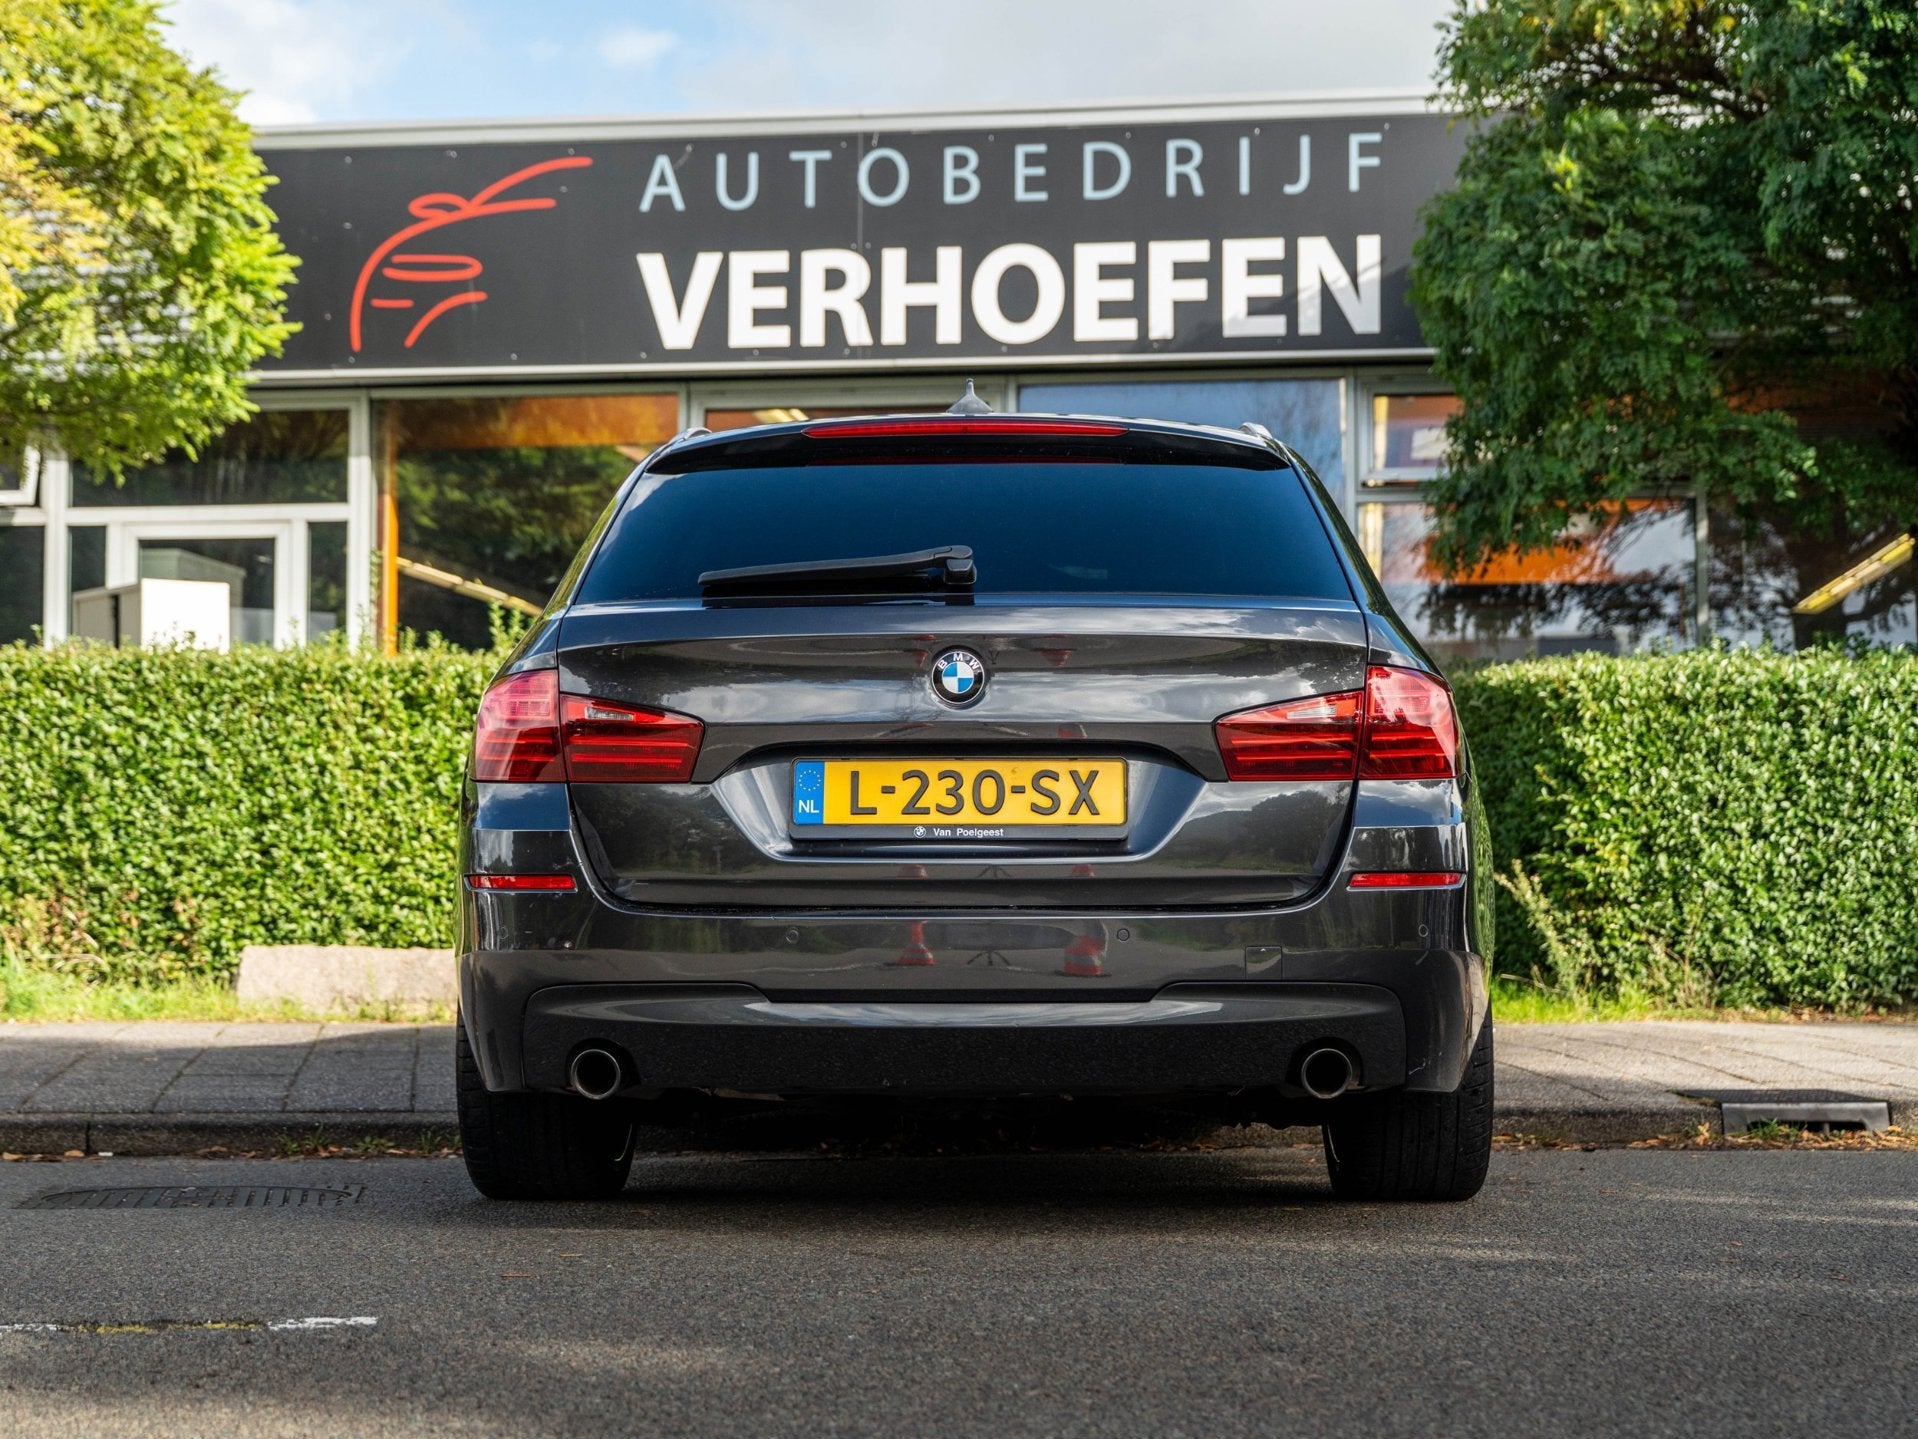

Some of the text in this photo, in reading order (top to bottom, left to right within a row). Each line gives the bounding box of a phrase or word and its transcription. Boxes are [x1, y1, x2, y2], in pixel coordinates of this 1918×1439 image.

[638, 132, 1384, 213] AUTOBEDRIJF
[636, 234, 1382, 350] VERHOEFEN
[937, 652, 980, 671] BMW
[798, 799, 820, 814] NL
[850, 769, 1101, 816] L-230-SX
[933, 828, 1004, 838] Van Poelgeest
